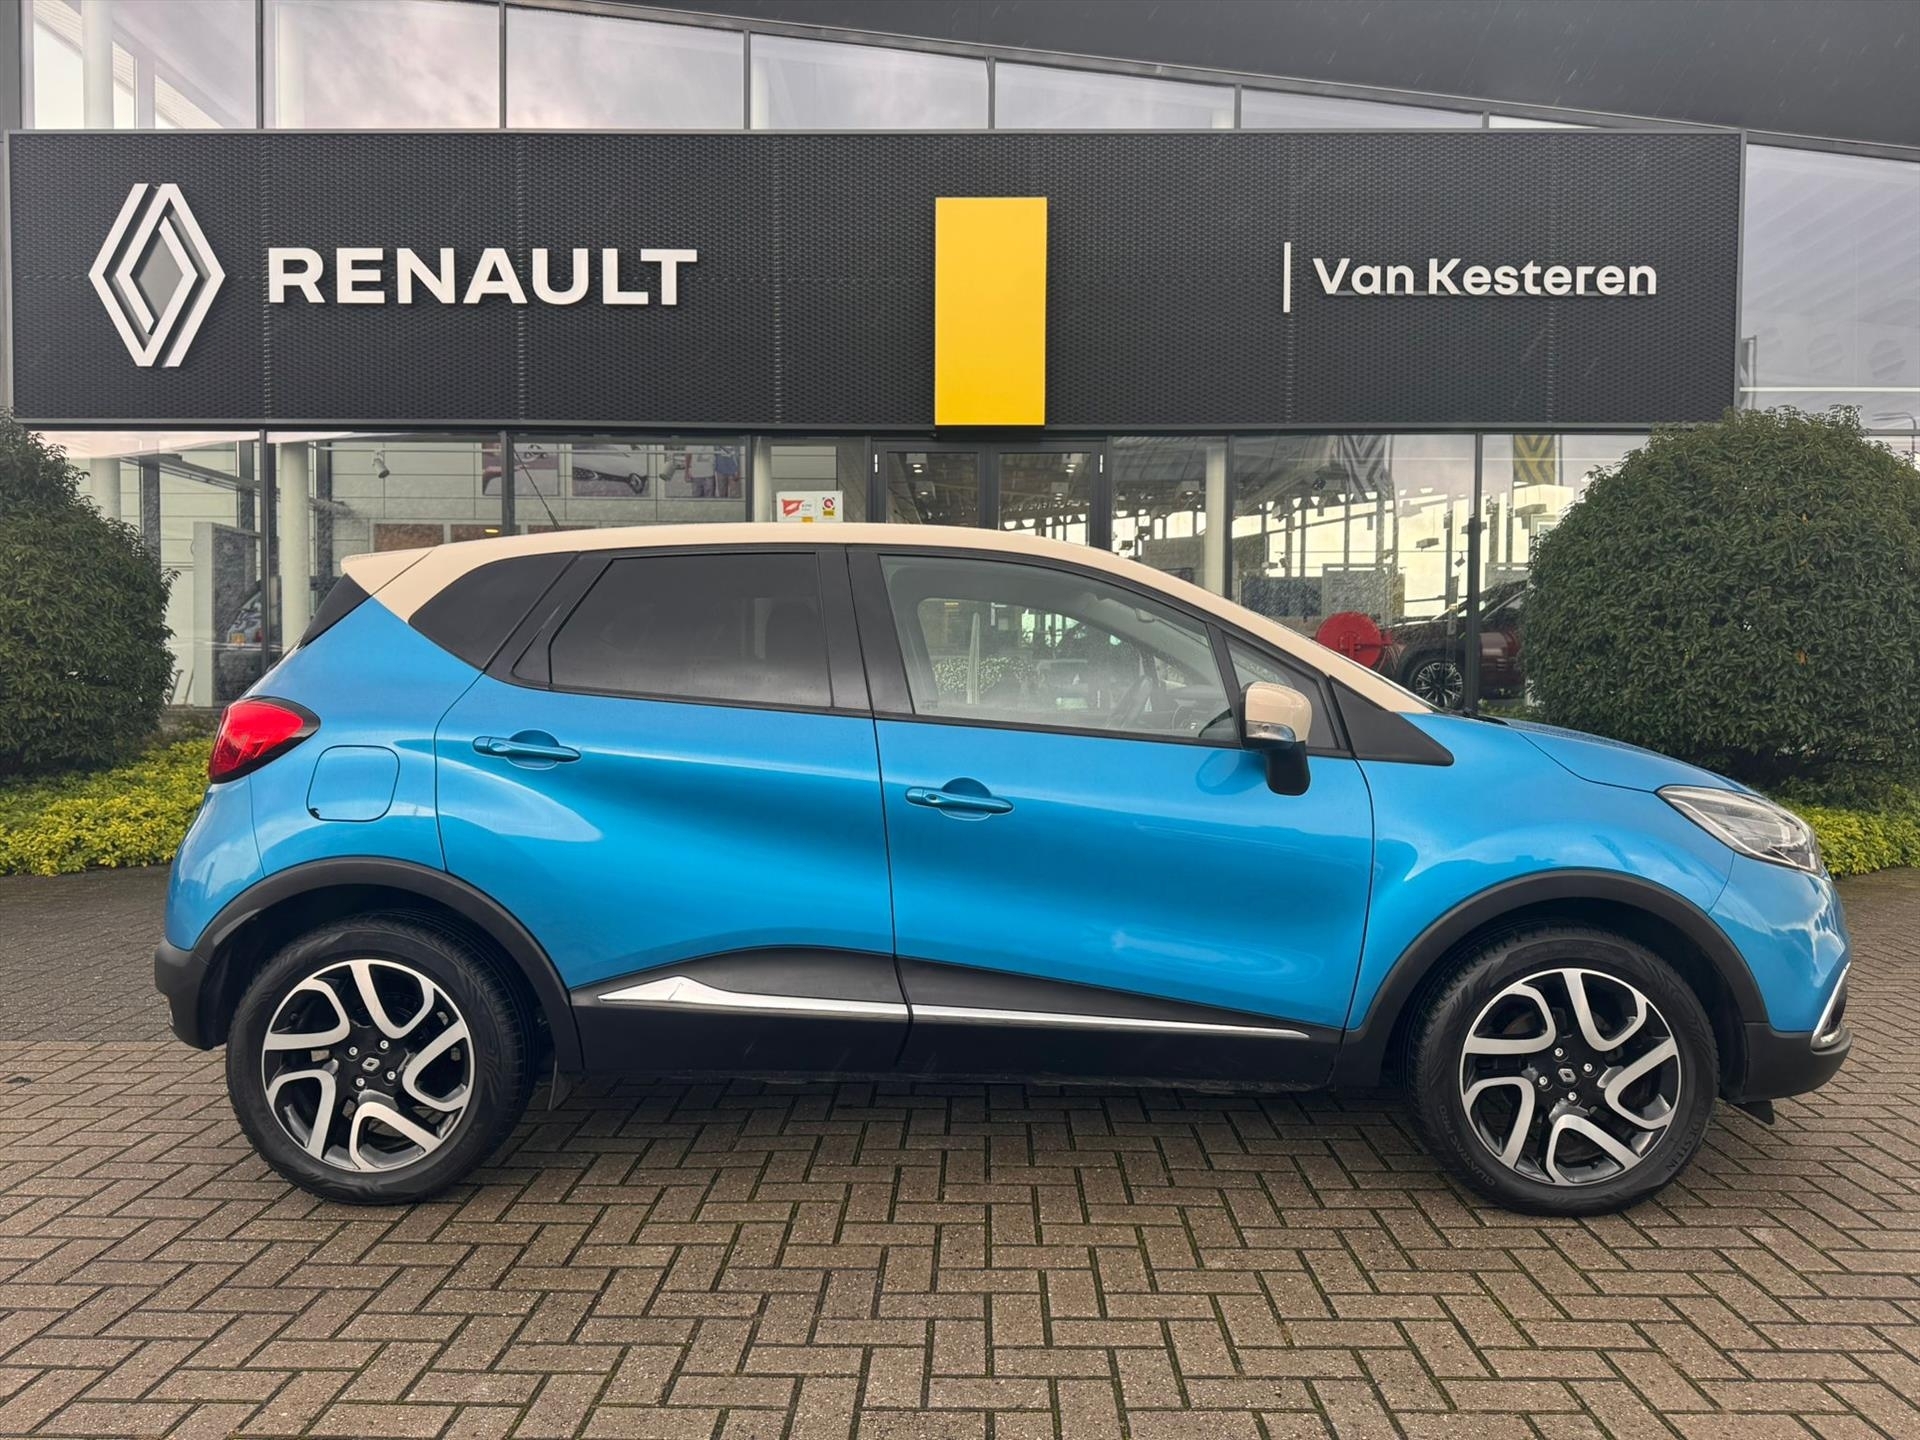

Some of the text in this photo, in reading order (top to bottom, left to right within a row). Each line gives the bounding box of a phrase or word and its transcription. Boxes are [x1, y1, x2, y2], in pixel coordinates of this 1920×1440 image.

[268, 248, 698, 306] RENAULT
[1313, 257, 1658, 296] Van Kesteren
